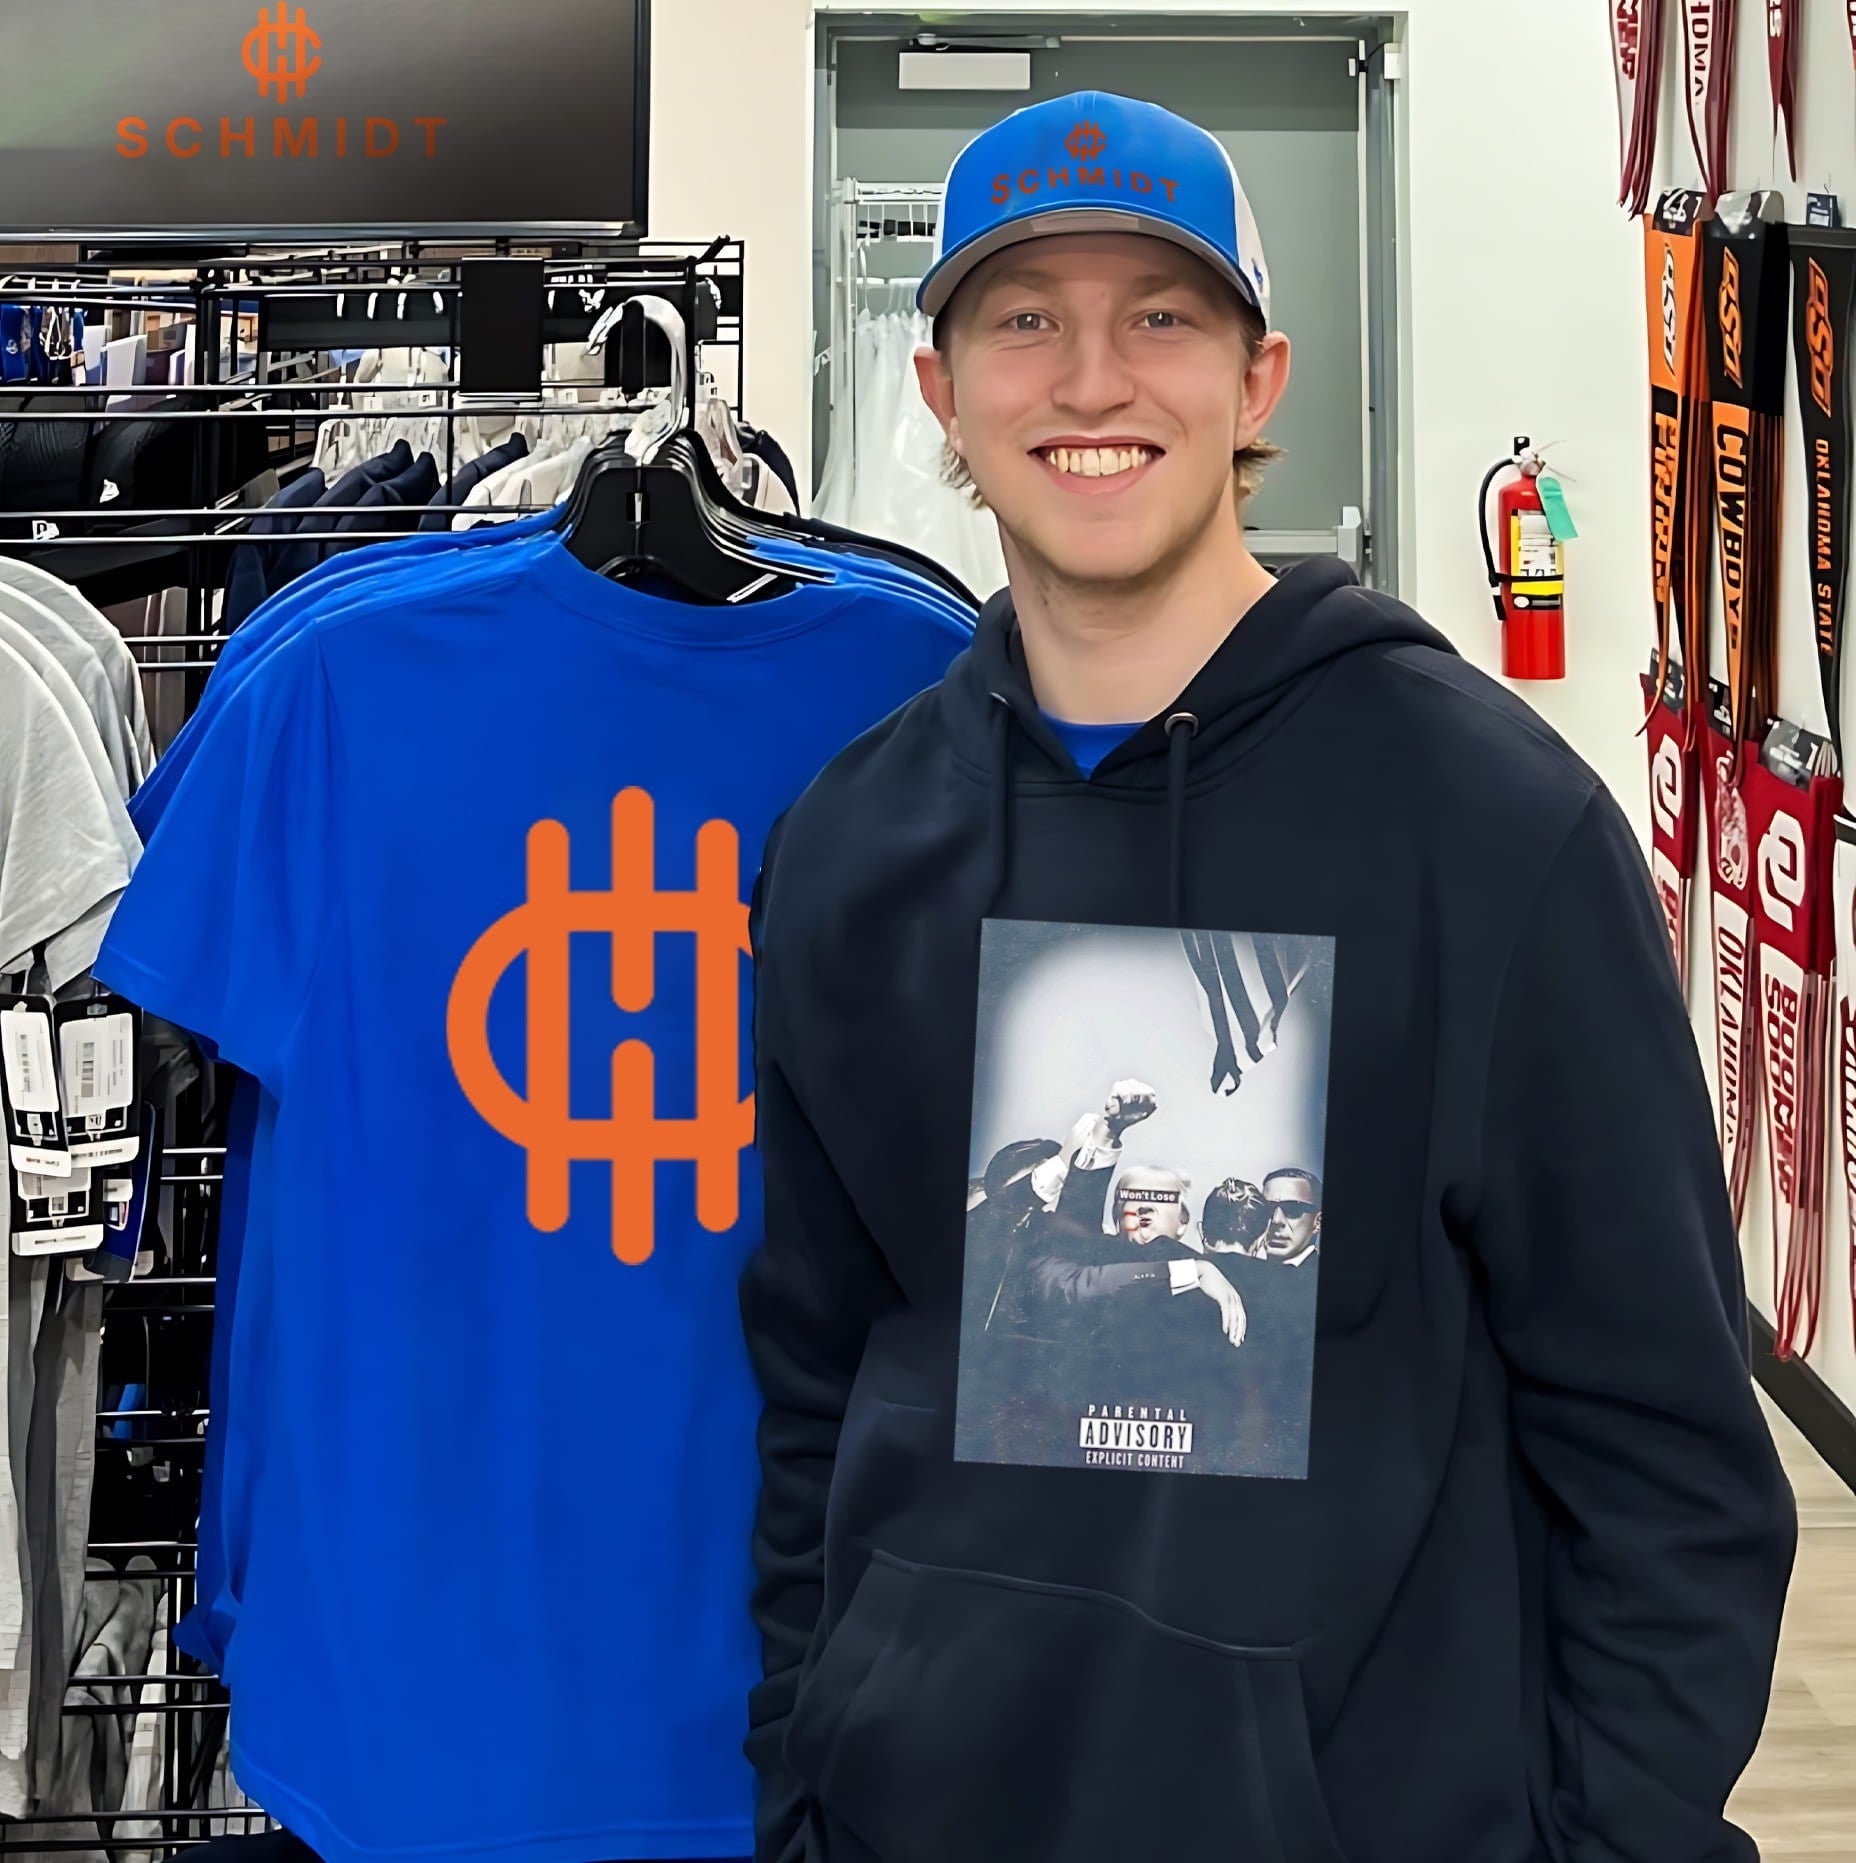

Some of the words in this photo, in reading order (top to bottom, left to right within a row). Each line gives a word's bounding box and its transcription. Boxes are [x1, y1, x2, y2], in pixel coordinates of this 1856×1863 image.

[117, 117, 447, 159] SCHMIDT
[991, 166, 1180, 205] SCHMIDT
[1815, 438, 1832, 571] OKLAHOMA
[1717, 925, 1746, 1145] OKLAHOMA
[1120, 1189, 1149, 1200] Won't
[1151, 1191, 1176, 1202] Lose
[1088, 1404, 1187, 1421] PARENTAL
[1085, 1421, 1187, 1449] ADVISORY
[1085, 1450, 1133, 1466] EXPLICIT
[1137, 1453, 1185, 1469] CONTENT
